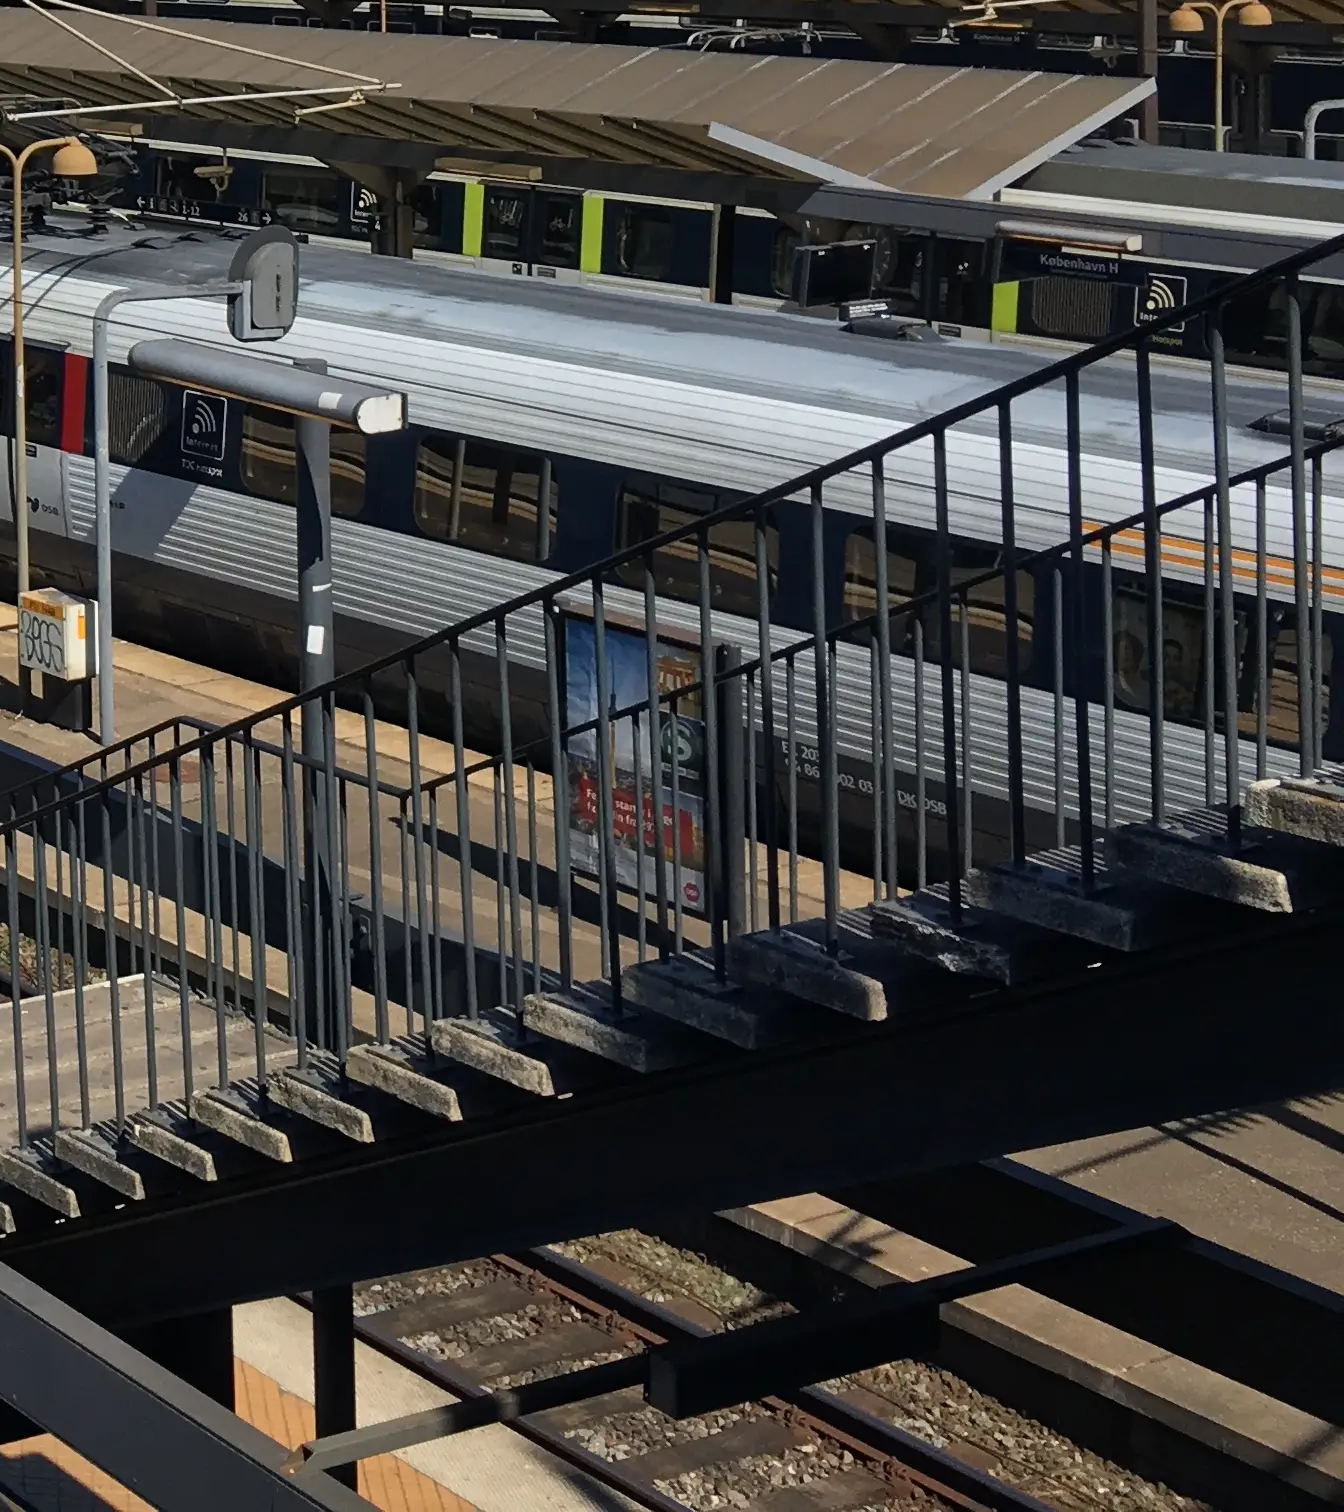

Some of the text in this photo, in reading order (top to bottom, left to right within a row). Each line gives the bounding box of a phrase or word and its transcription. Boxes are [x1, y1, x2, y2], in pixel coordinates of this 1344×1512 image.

[1040, 254, 1107, 273] København
[1109, 262, 1119, 274] H
[41, 503, 59, 516] DSB
